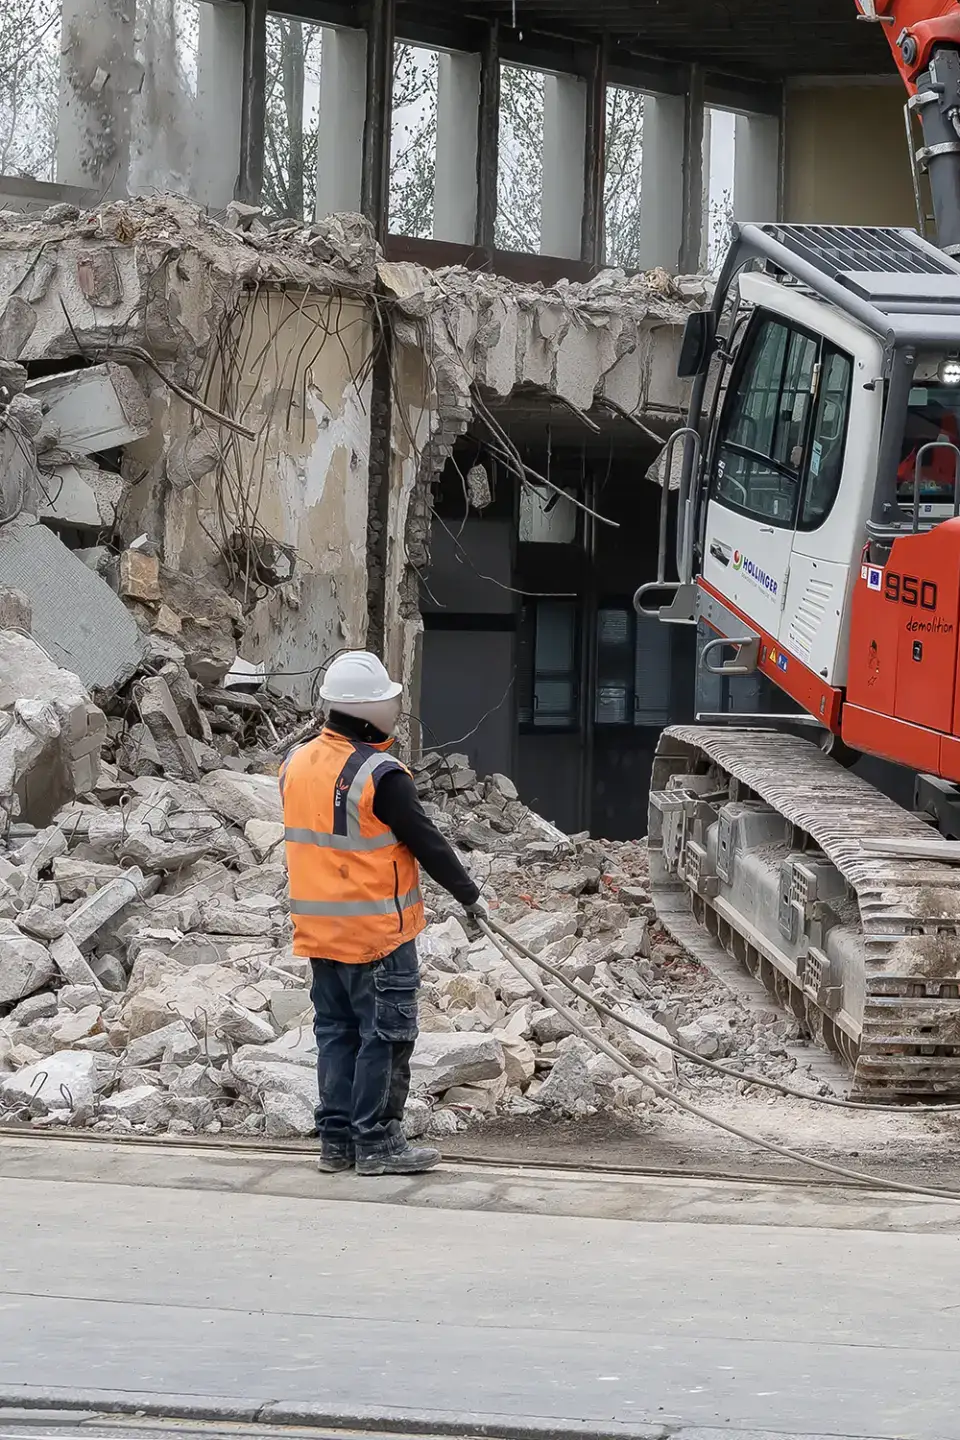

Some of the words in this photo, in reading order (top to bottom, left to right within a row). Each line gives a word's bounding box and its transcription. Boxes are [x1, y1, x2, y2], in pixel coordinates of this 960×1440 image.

[743, 556, 778, 595] HOLLINGER
[884, 570, 938, 612] 950
[906, 616, 953, 633] demolition
